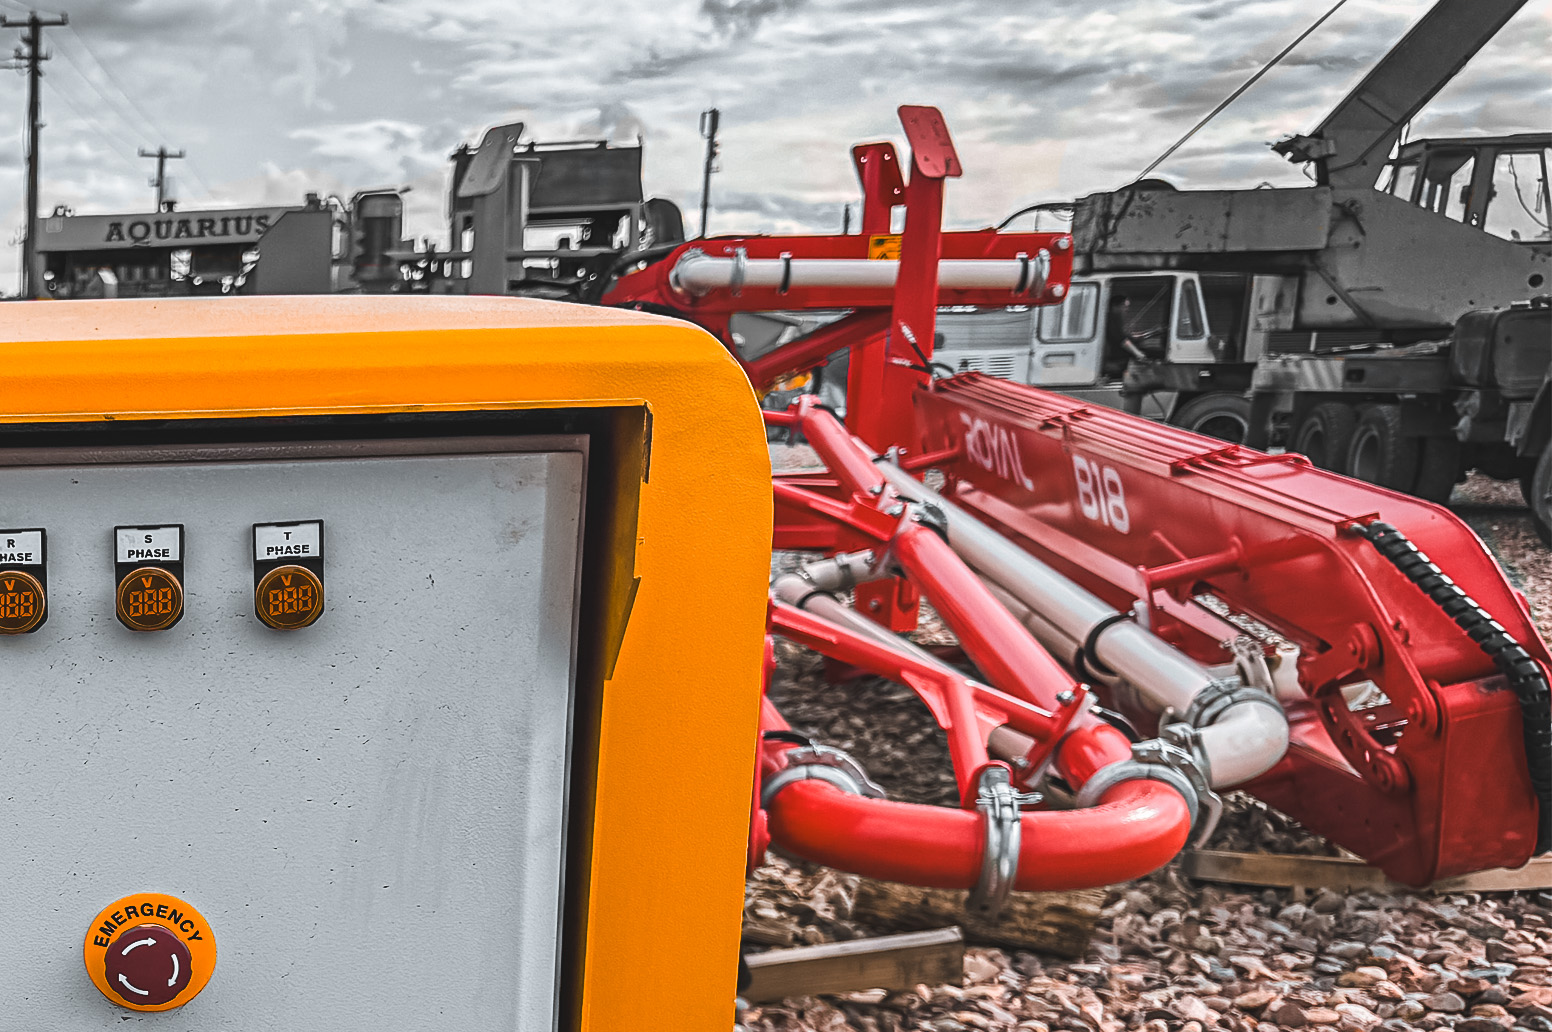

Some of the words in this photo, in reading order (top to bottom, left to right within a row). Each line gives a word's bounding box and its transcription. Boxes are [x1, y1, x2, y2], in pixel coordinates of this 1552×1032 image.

[105, 215, 271, 245] AQUARIUS
[1072, 454, 1130, 536] B18
[144, 534, 154, 544] S
[284, 531, 292, 541] T
[6, 538, 16, 548] R
[128, 548, 170, 559] PHASE
[266, 544, 310, 556] PHASE
[94, 903, 203, 948] EMERGENCY
